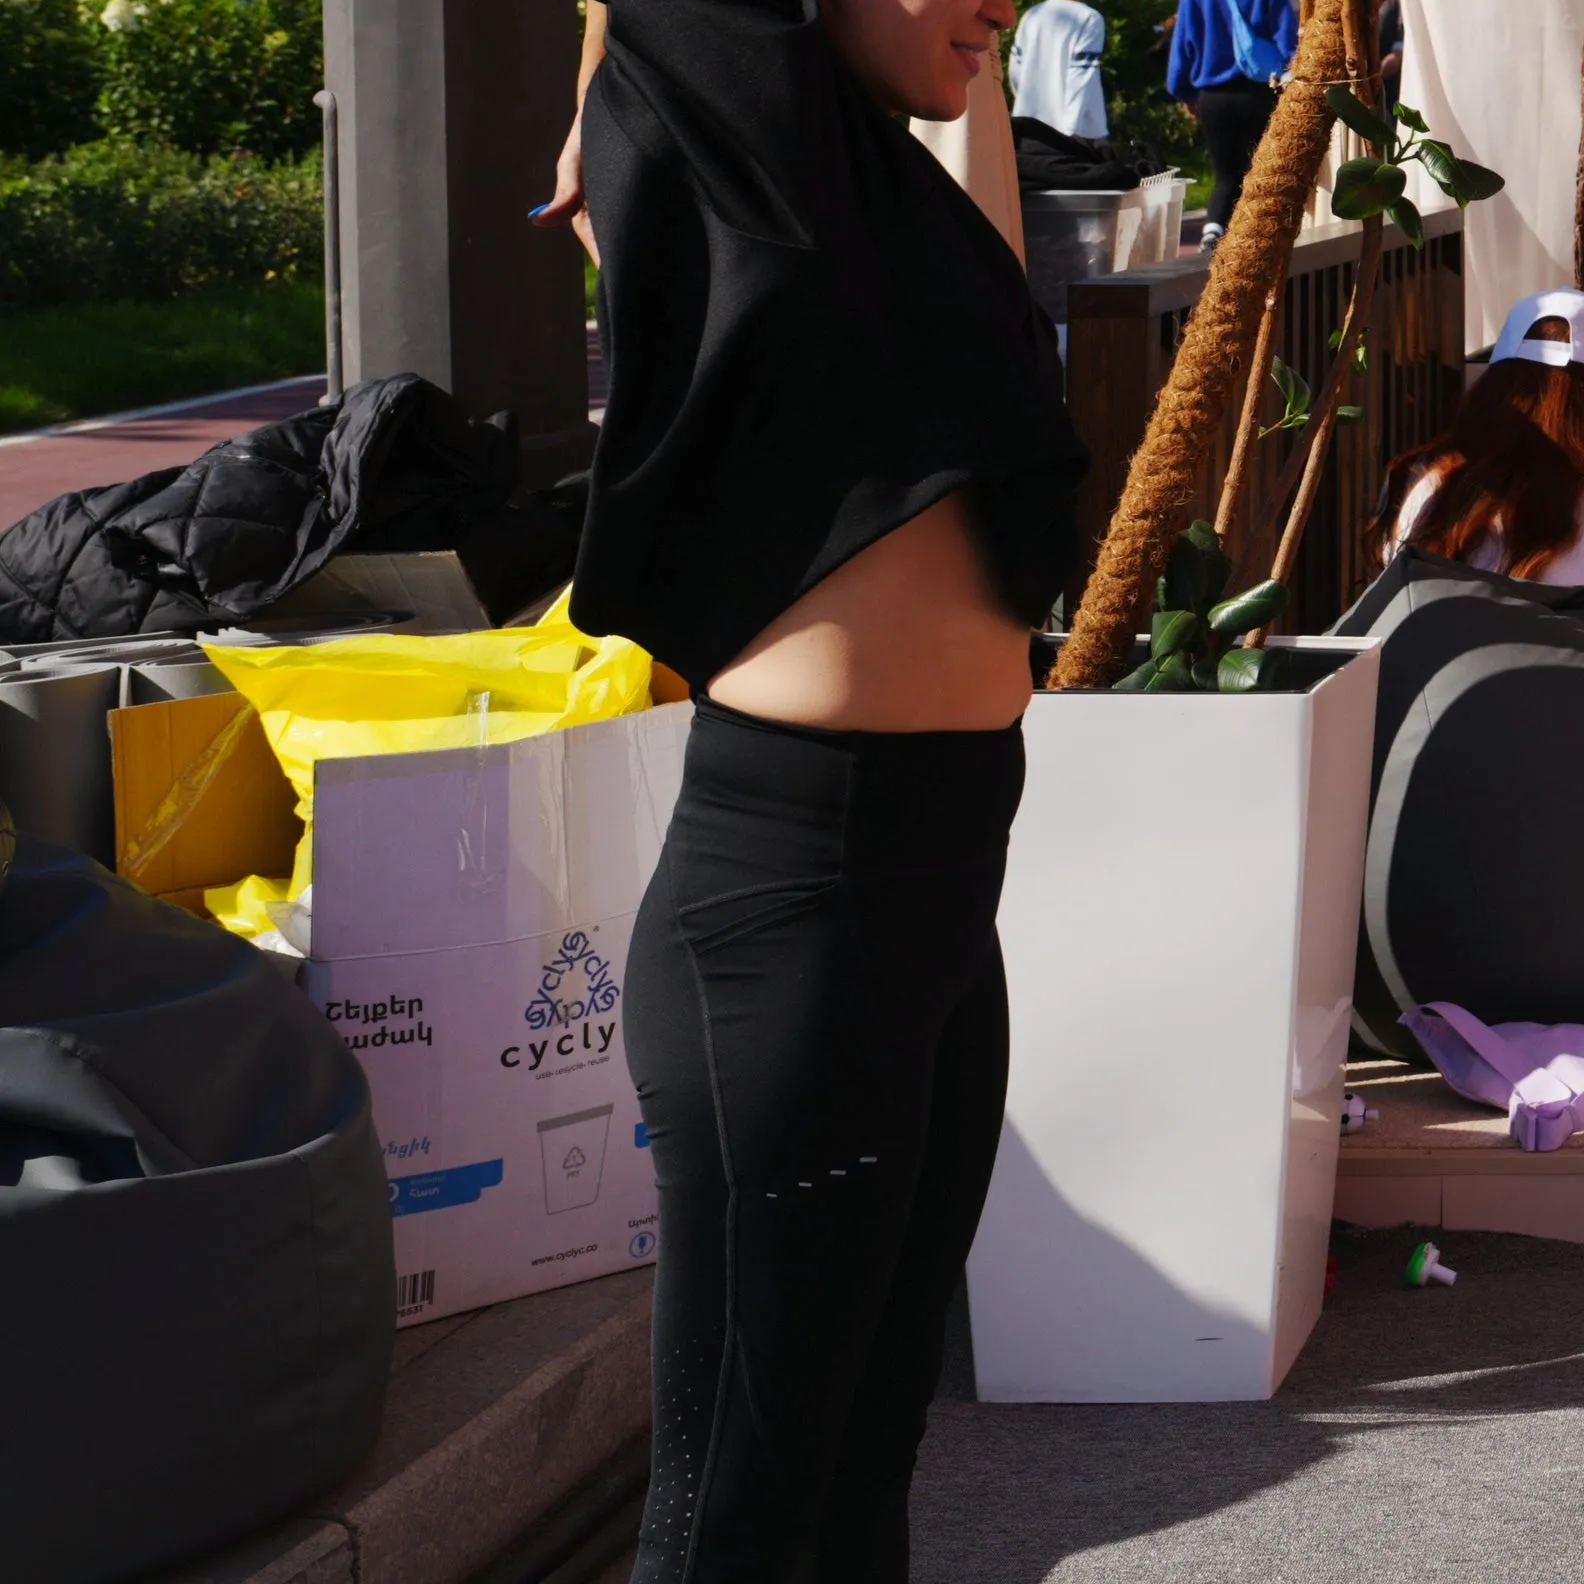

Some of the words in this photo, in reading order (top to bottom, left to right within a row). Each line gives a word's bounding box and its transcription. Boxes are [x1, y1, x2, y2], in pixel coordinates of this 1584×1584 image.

[325, 995, 423, 1025] Շեյքեր
[344, 1021, 433, 1050] աժակ
[500, 1022, 617, 1070] cycly
